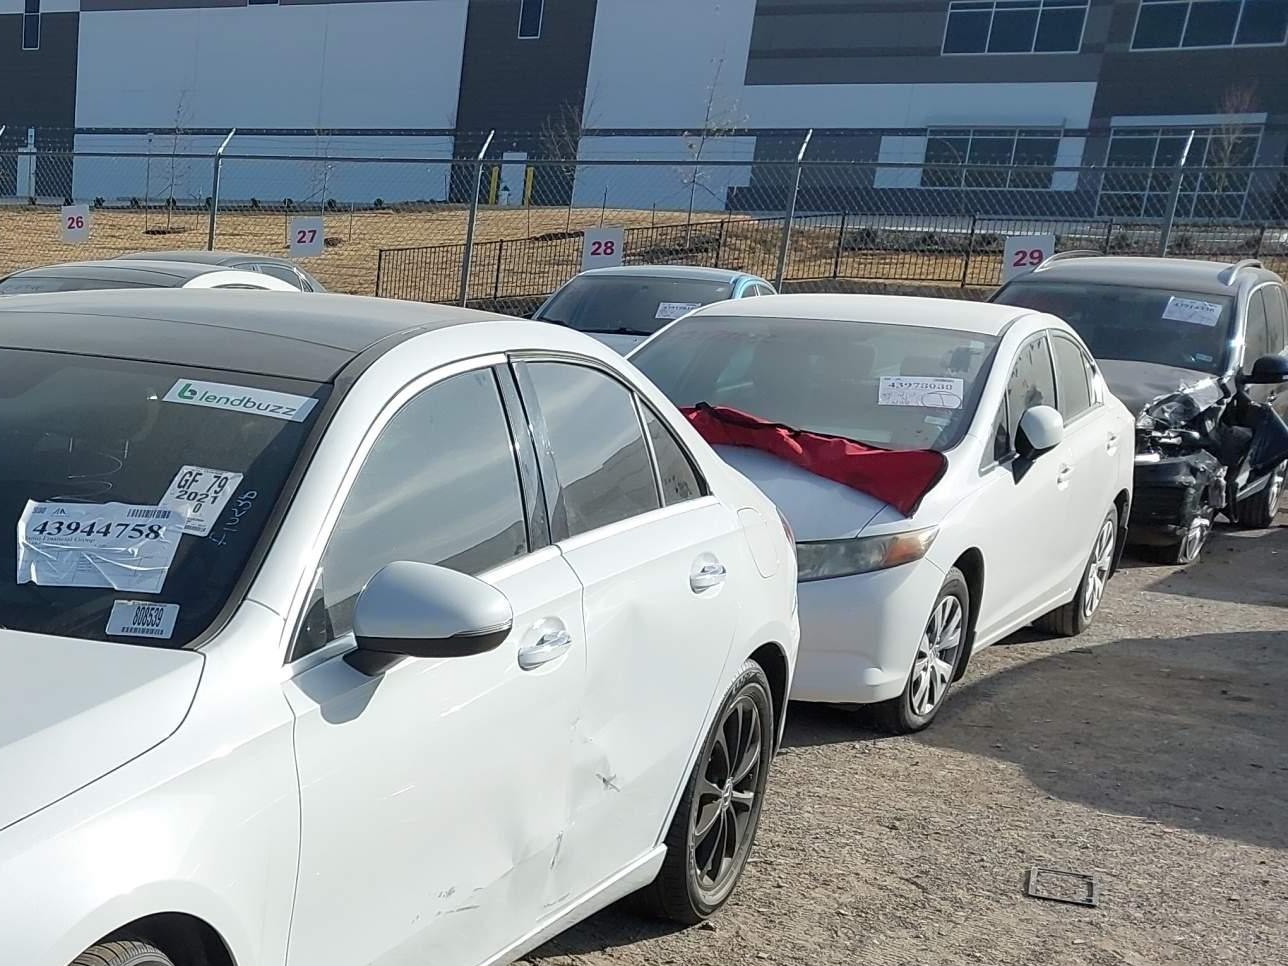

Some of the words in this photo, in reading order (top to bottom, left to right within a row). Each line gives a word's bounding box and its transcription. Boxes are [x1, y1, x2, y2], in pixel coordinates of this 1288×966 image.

[67, 216, 84, 229] 26
[296, 229, 317, 244] 27
[590, 241, 615, 256] 28
[1013, 249, 1043, 267] 29
[198, 391, 298, 416] lendbuzz
[177, 471, 203, 490] GF
[206, 474, 229, 495] 79
[175, 489, 220, 505] 2021
[192, 502, 203, 514] 0
[32, 520, 162, 541] 43944758
[132, 606, 164, 628] 808539
